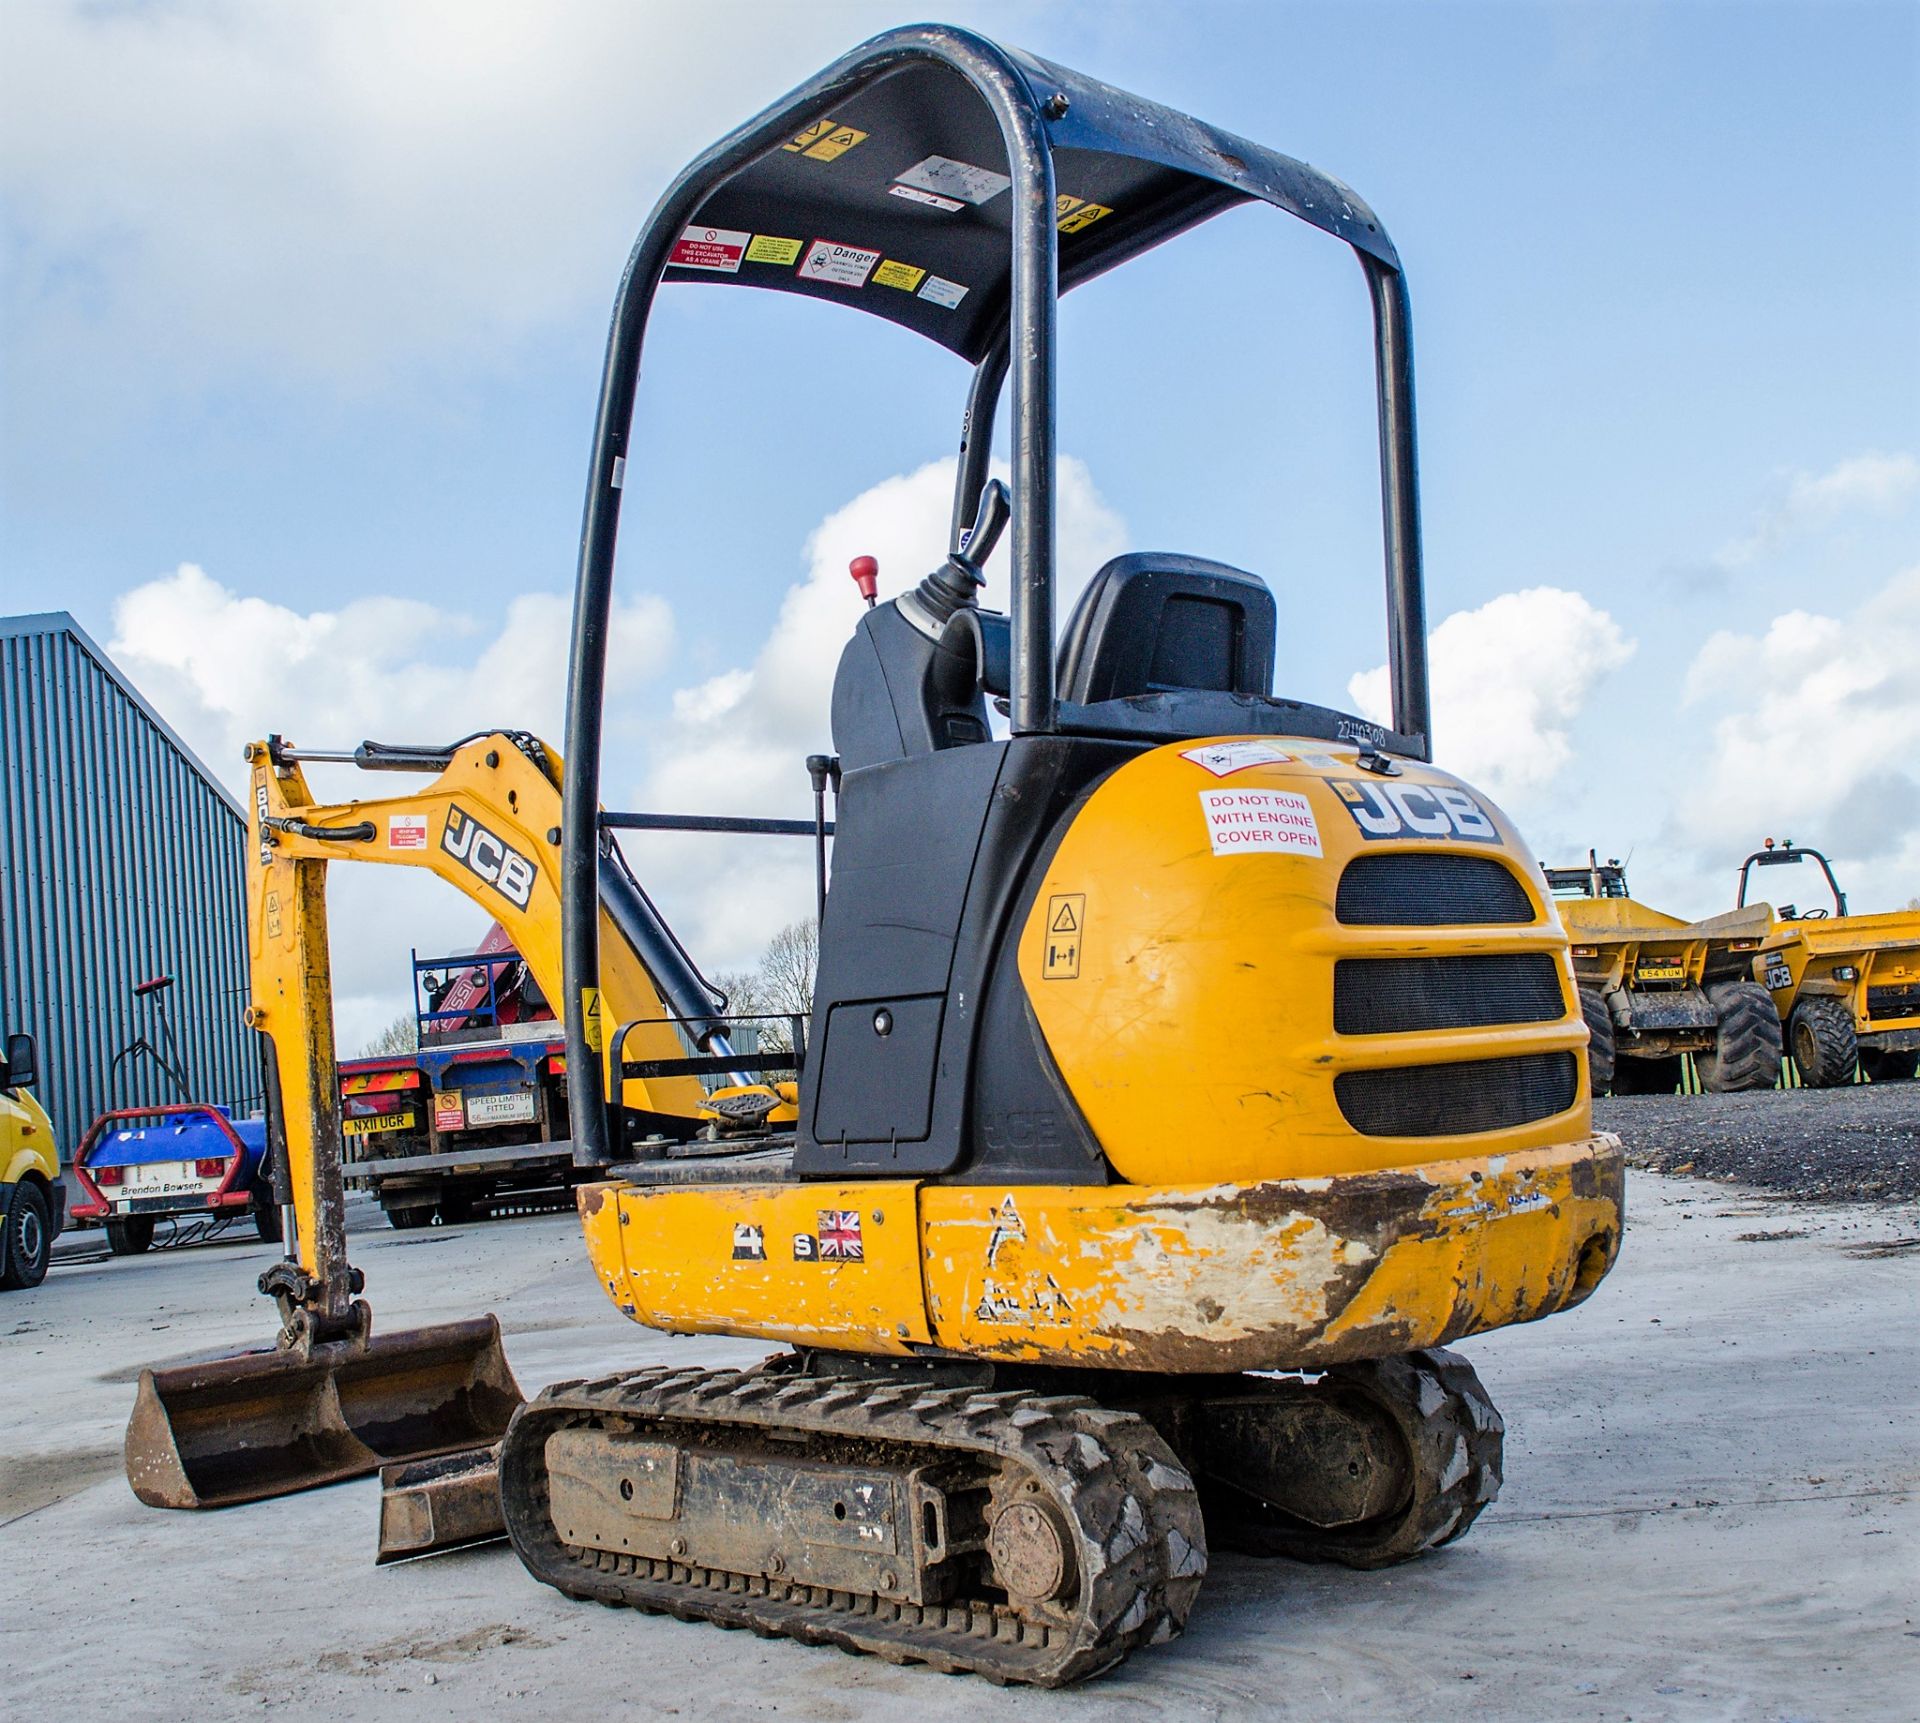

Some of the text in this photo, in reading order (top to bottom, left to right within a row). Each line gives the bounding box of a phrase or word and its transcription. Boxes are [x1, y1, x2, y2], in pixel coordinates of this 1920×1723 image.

[833, 246, 877, 263] Danger
[1210, 795, 1306, 810] DO NOT RUN
[1352, 781, 1496, 838] JCB
[1211, 812, 1314, 828] WITH ENGINE
[1216, 830, 1318, 847] COVER OPEN
[444, 818, 534, 906] JCB
[1765, 966, 1793, 990] JCB
[470, 1093, 532, 1106] SPEED LIMITER
[487, 1104, 514, 1113] FITTED
[354, 1115, 405, 1132] NX11 UGR
[121, 1182, 204, 1196] Brendon Bowsers
